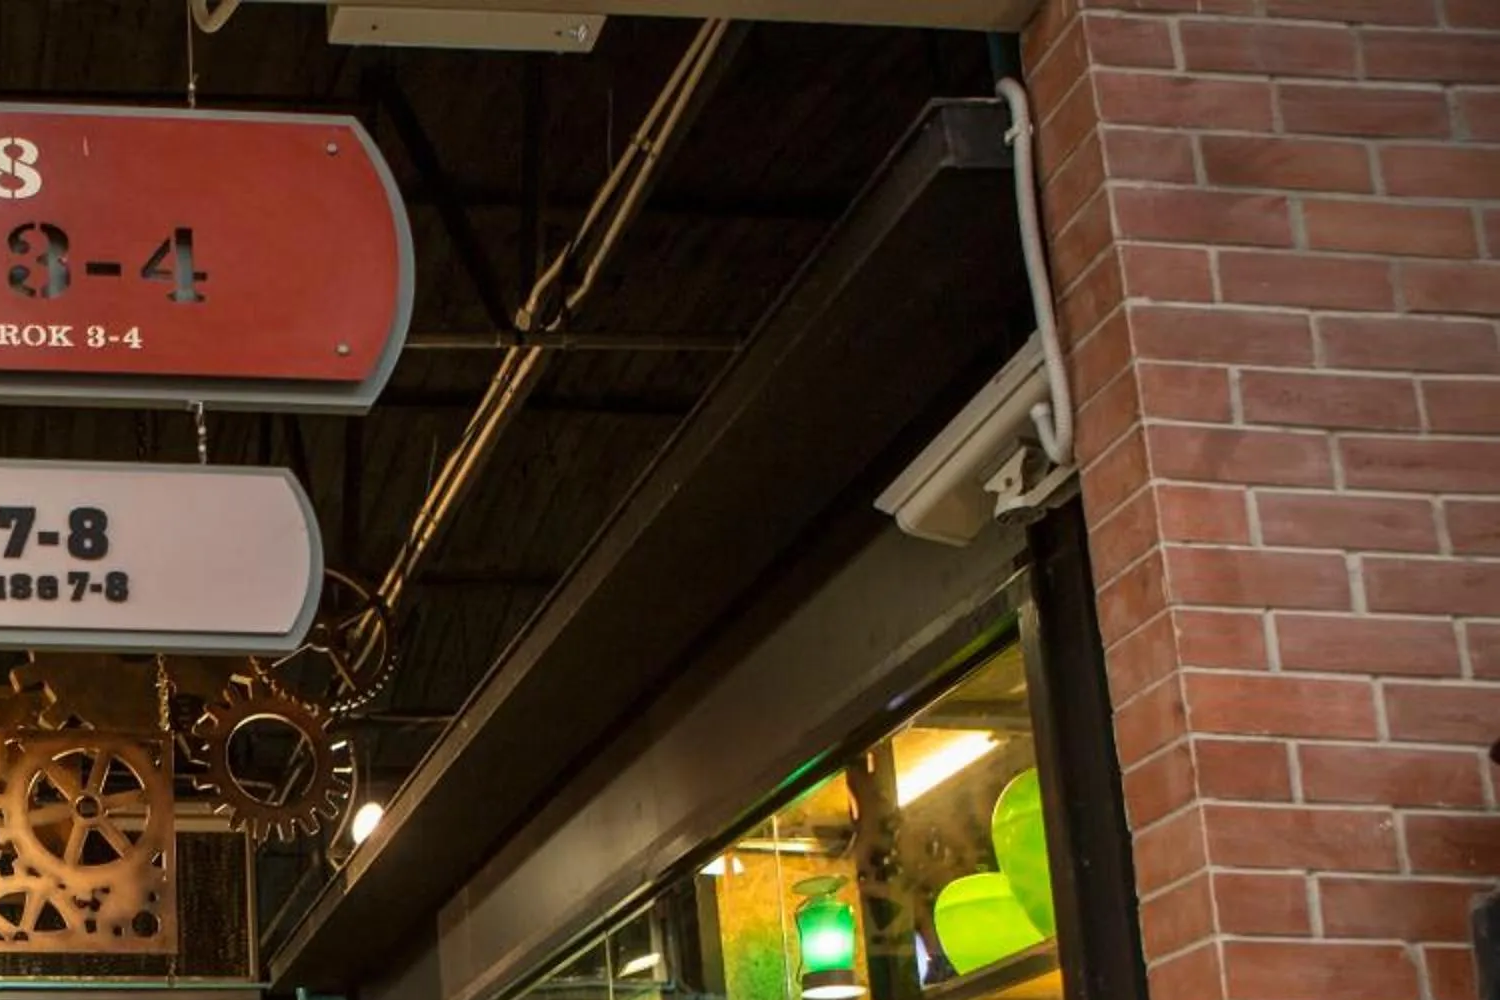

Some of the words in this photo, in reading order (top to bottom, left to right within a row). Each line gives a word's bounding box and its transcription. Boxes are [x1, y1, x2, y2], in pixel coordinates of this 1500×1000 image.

[7, 221, 208, 302] 3-4
[86, 325, 143, 349] 3-4
[67, 570, 129, 603] 7-8
